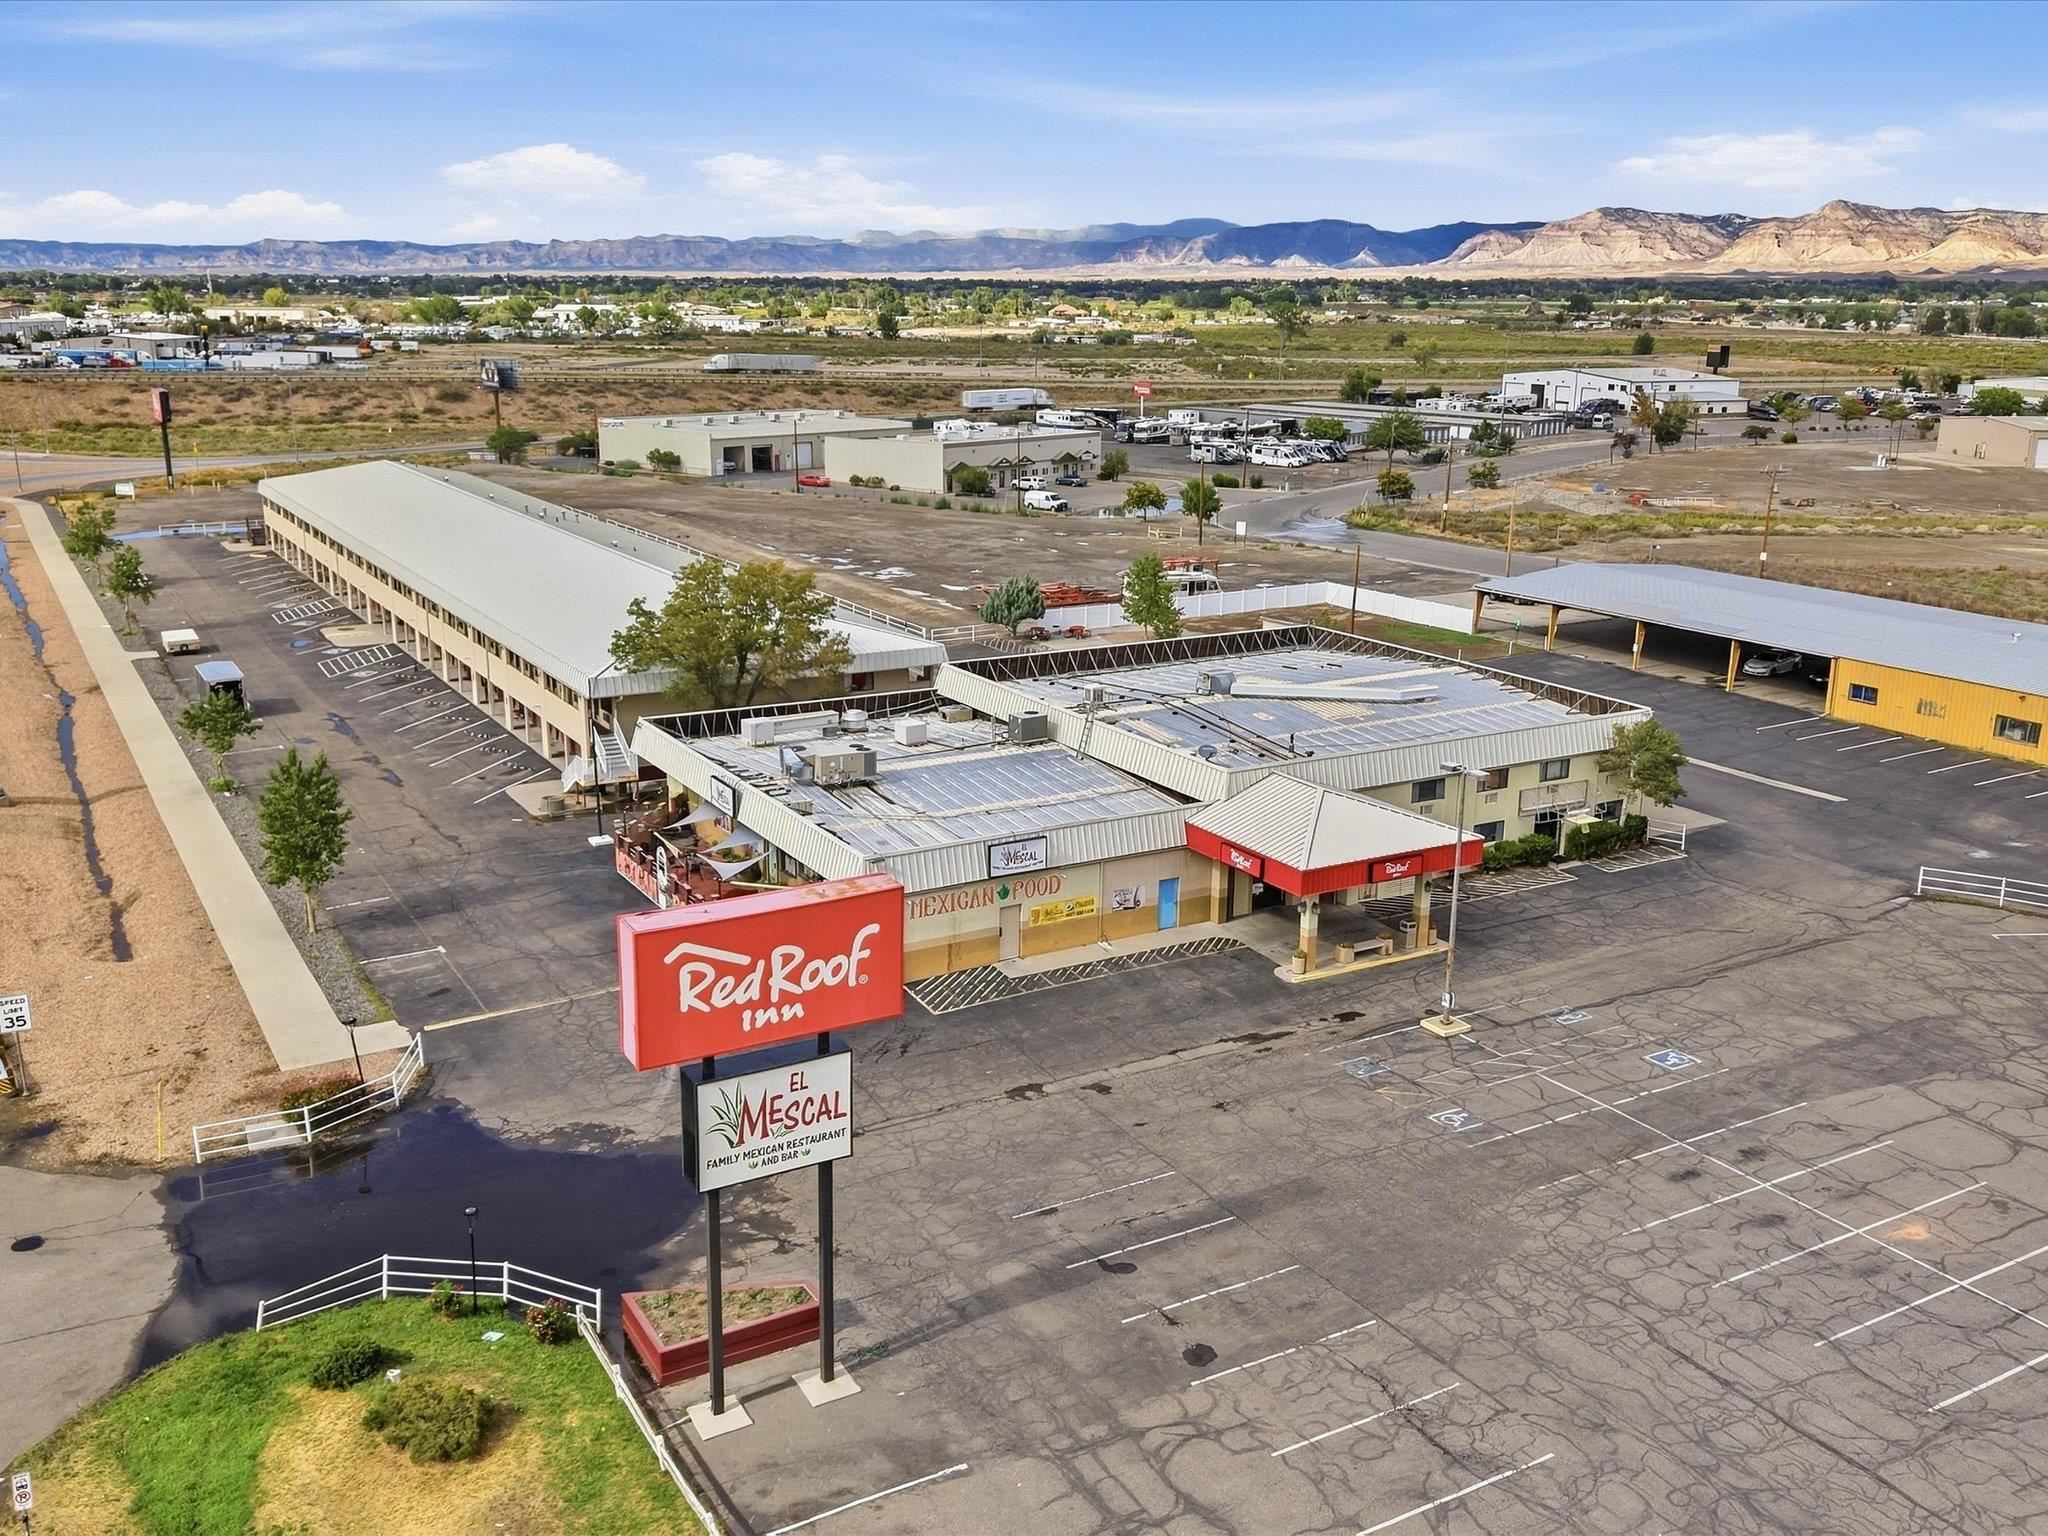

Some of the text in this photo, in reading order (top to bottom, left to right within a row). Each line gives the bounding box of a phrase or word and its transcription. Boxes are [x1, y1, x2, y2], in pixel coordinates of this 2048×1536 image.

[1008, 849, 1038, 865] MESCAL
[908, 874, 1063, 920] MEXICAN FOOD
[0, 998, 25, 1006] SPEED
[3, 1007, 23, 1015] LIMIT
[4, 1015, 27, 1029] 35
[789, 1070, 809, 1093] EL
[735, 1088, 848, 1147] MESCAL
[706, 1127, 848, 1170] FAMILY MEXICAN RESTAURANT
[760, 1149, 799, 1167] AND BAR
